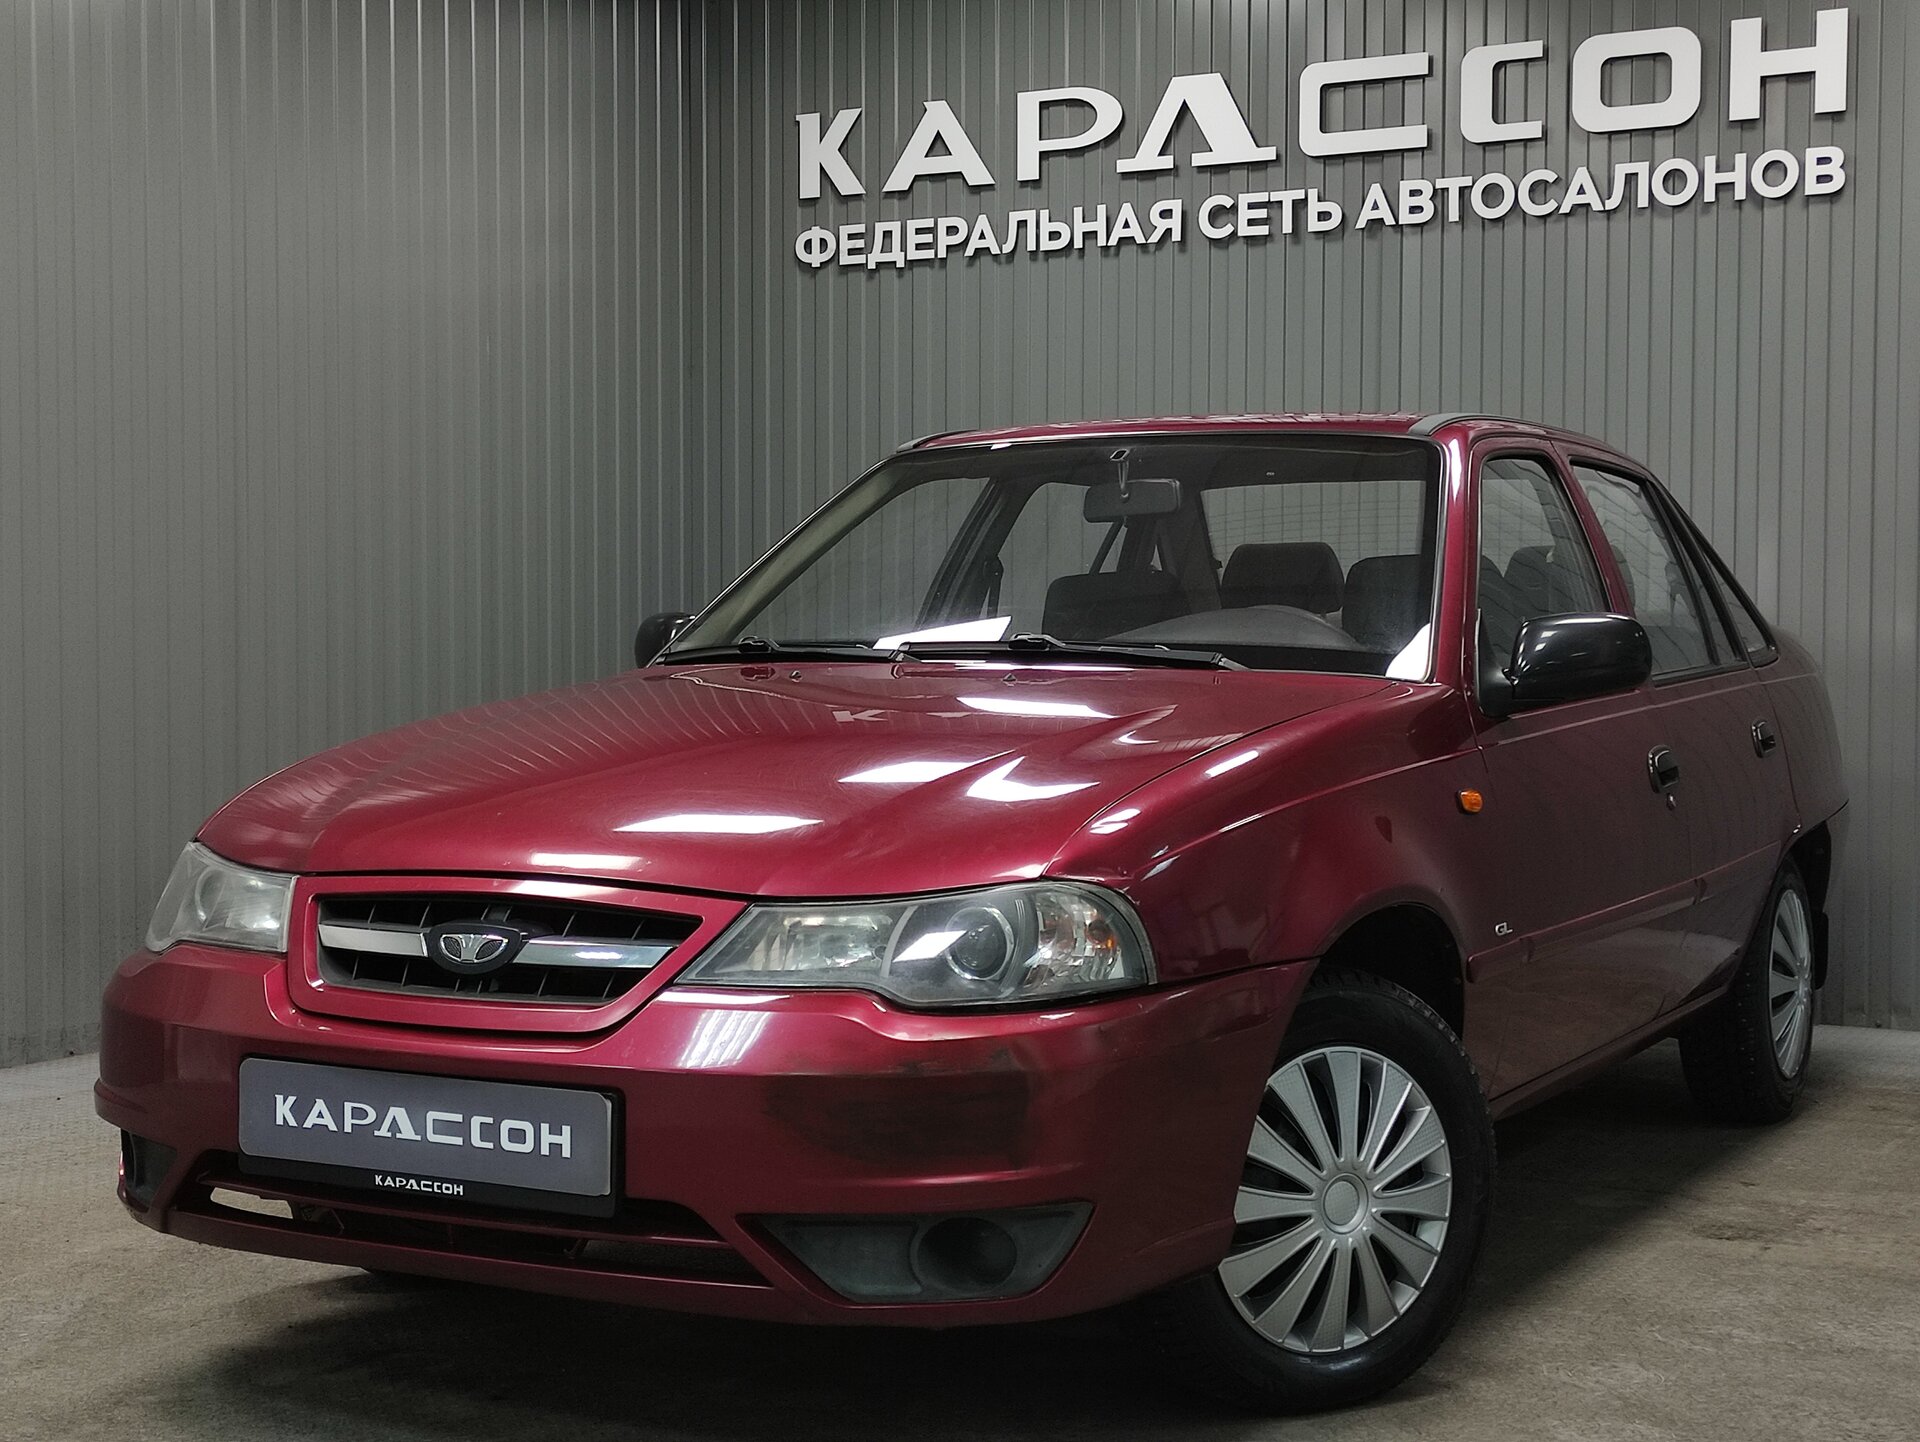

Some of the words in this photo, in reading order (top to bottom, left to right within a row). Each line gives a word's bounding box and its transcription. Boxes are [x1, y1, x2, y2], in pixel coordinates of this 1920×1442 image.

[795, 199, 1183, 270] ФЕДЕРАЛЬНАЯ
[1198, 188, 1343, 241] СЕТЬ
[1355, 146, 1847, 230] АВТОСАЛОНОВ
